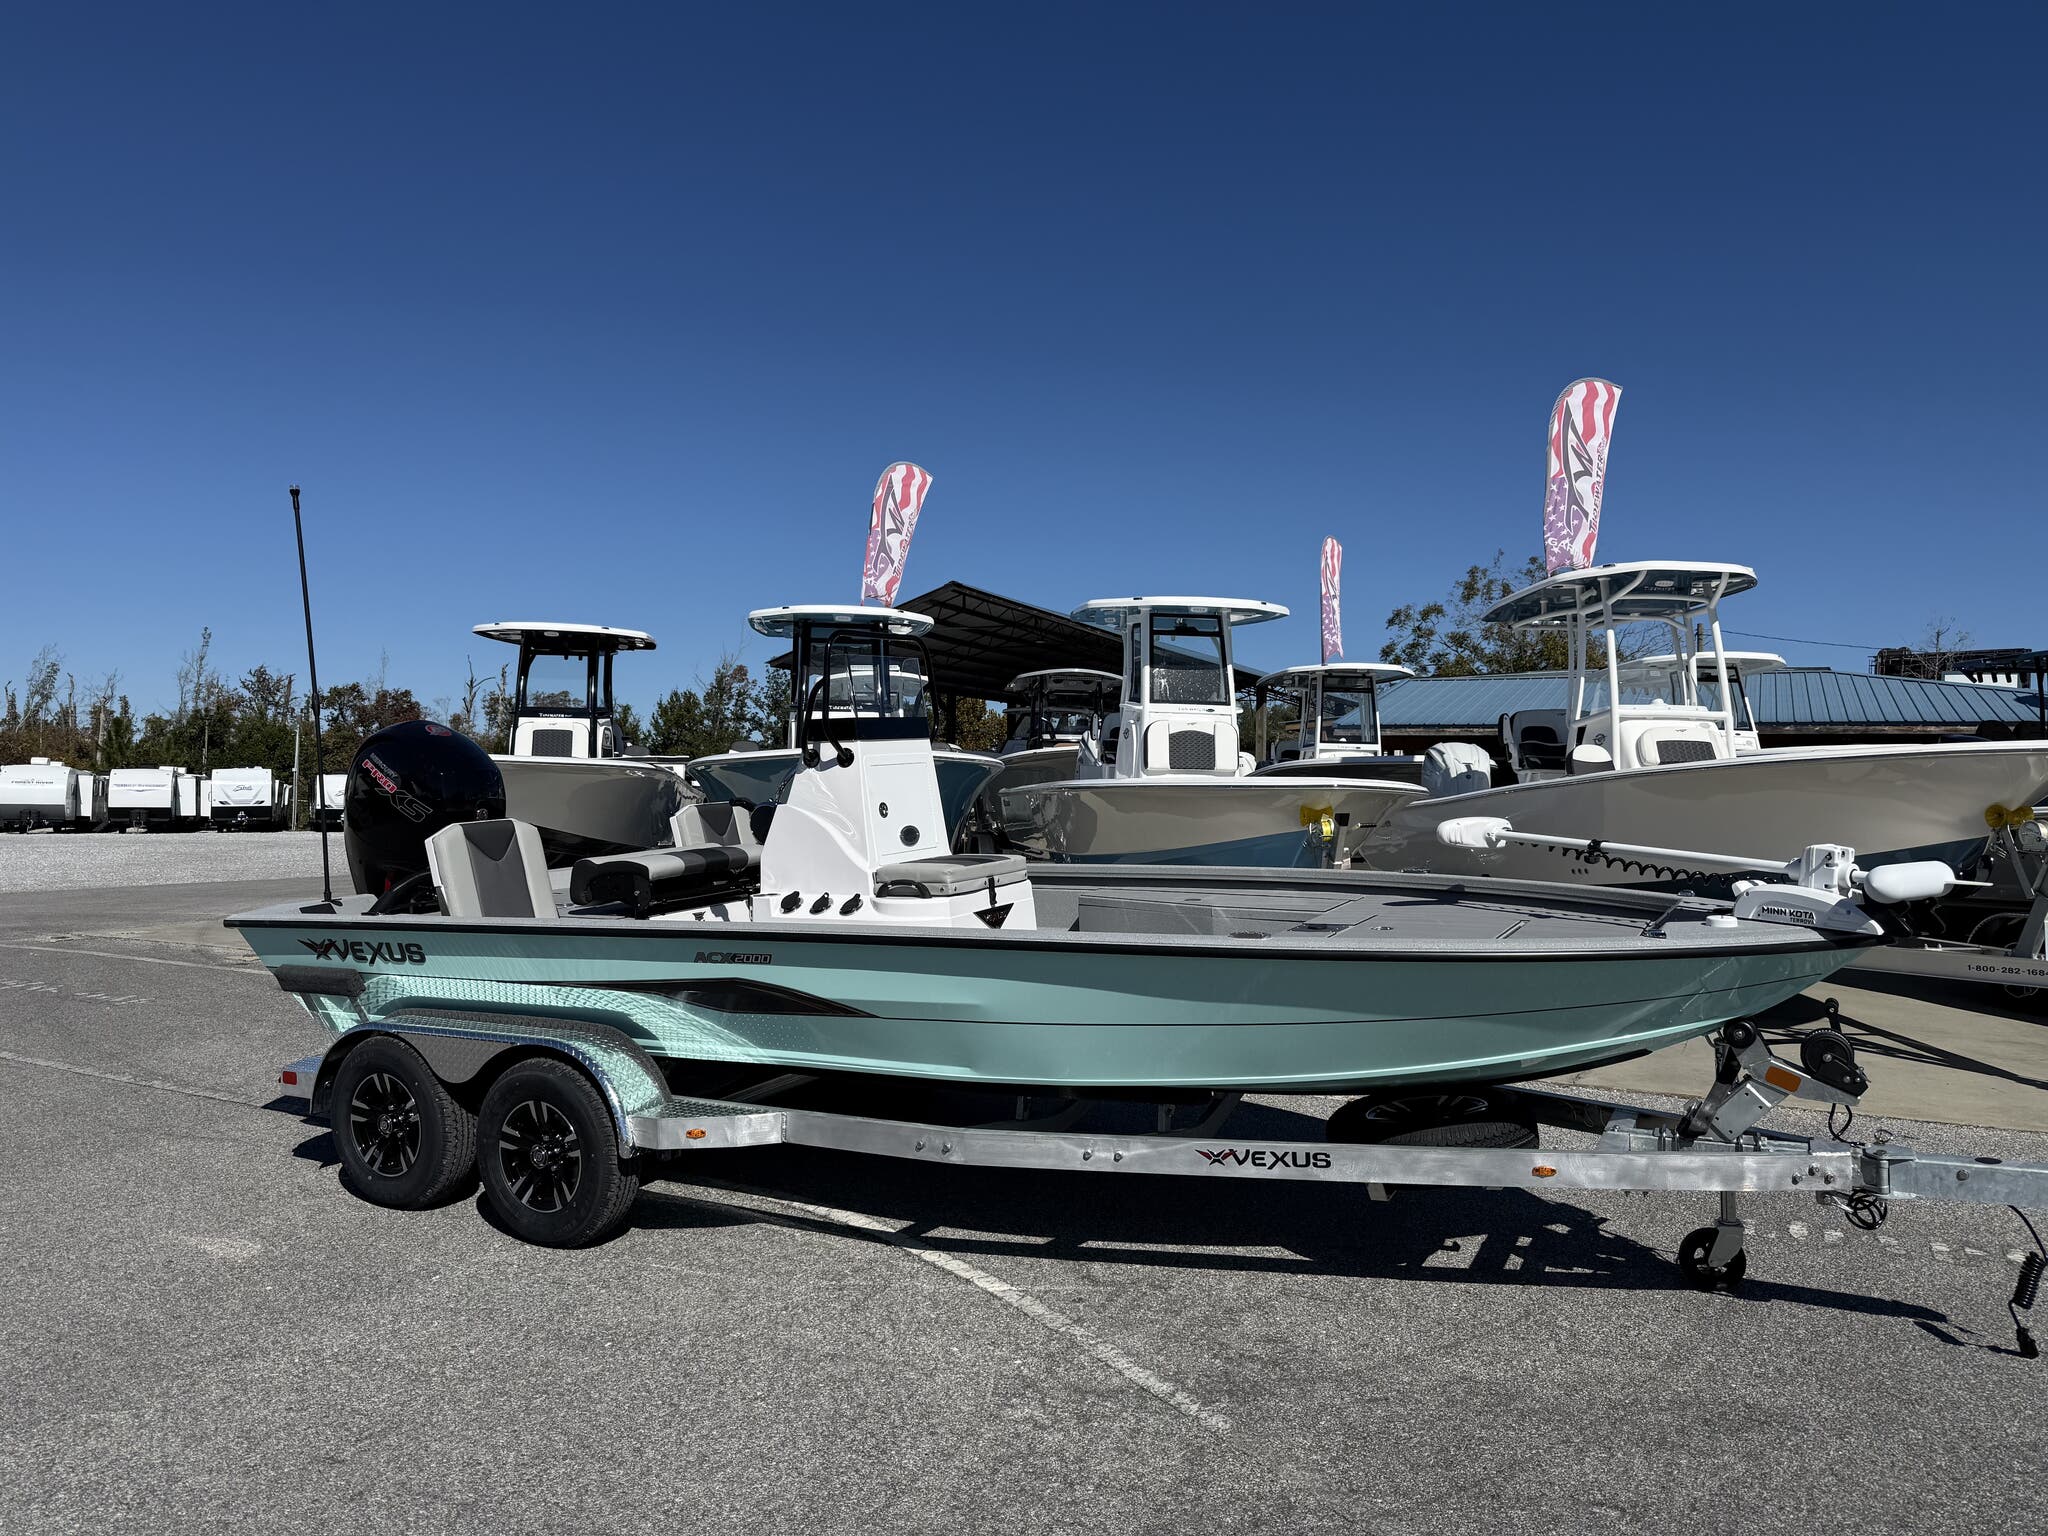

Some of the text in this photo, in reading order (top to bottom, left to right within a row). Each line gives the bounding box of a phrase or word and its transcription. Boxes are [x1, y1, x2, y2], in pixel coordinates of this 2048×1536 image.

[1762, 906, 1814, 919] MINN KOTA
[328, 938, 426, 966] VEXUS
[1228, 1149, 1331, 1169] VEXUS
